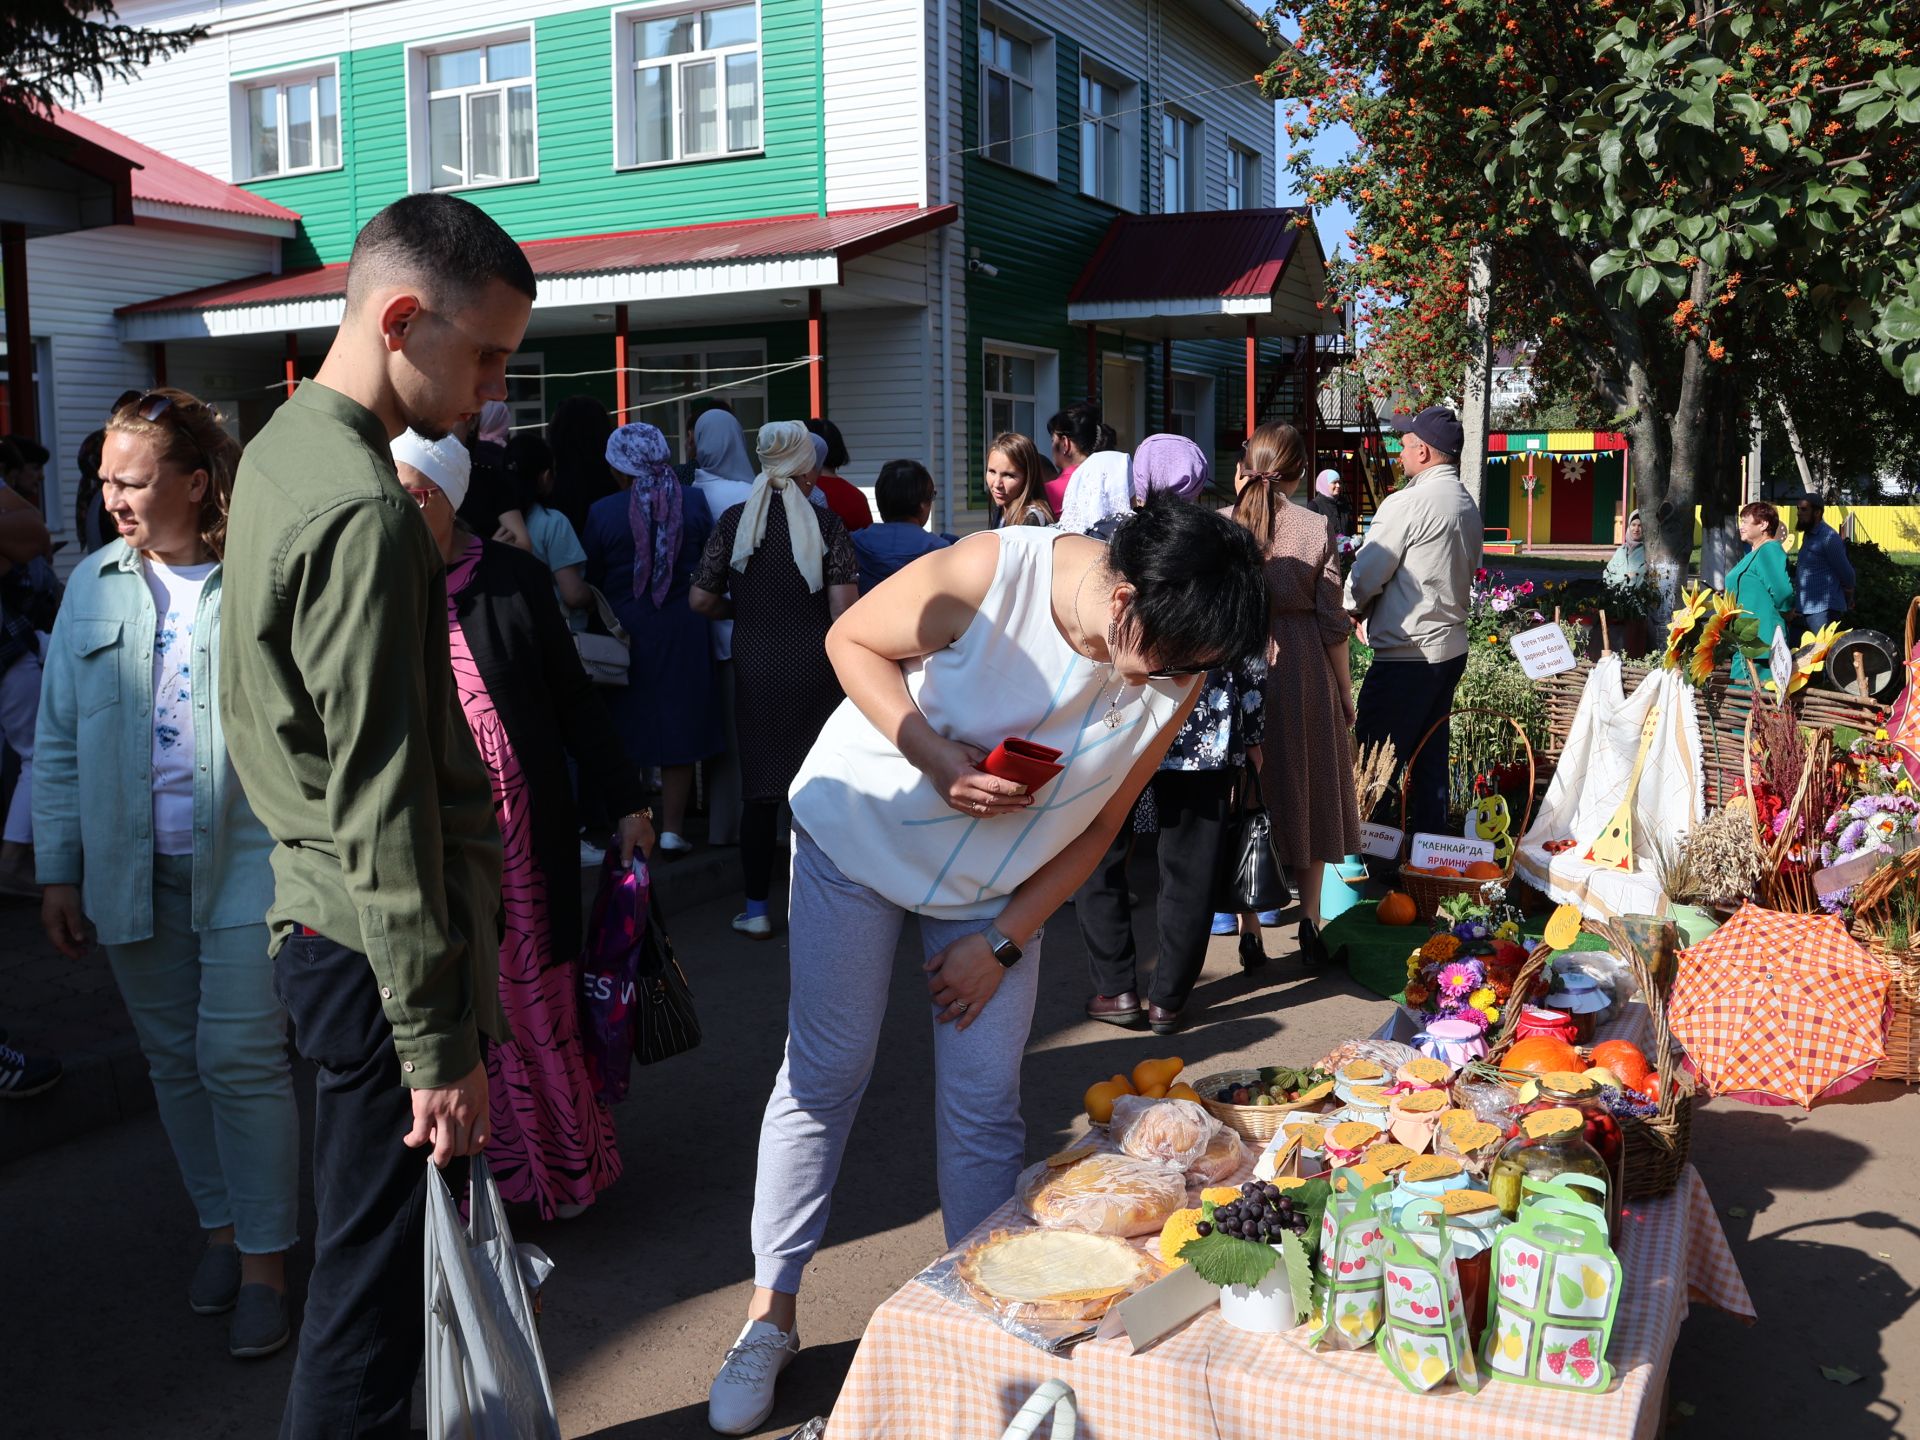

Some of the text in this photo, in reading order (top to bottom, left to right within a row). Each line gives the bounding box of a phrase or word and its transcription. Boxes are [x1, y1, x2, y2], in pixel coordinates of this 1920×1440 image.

[1524, 649, 1547, 660] варенье
[1369, 831, 1395, 841] кабак
[583, 972, 612, 1000] ES
